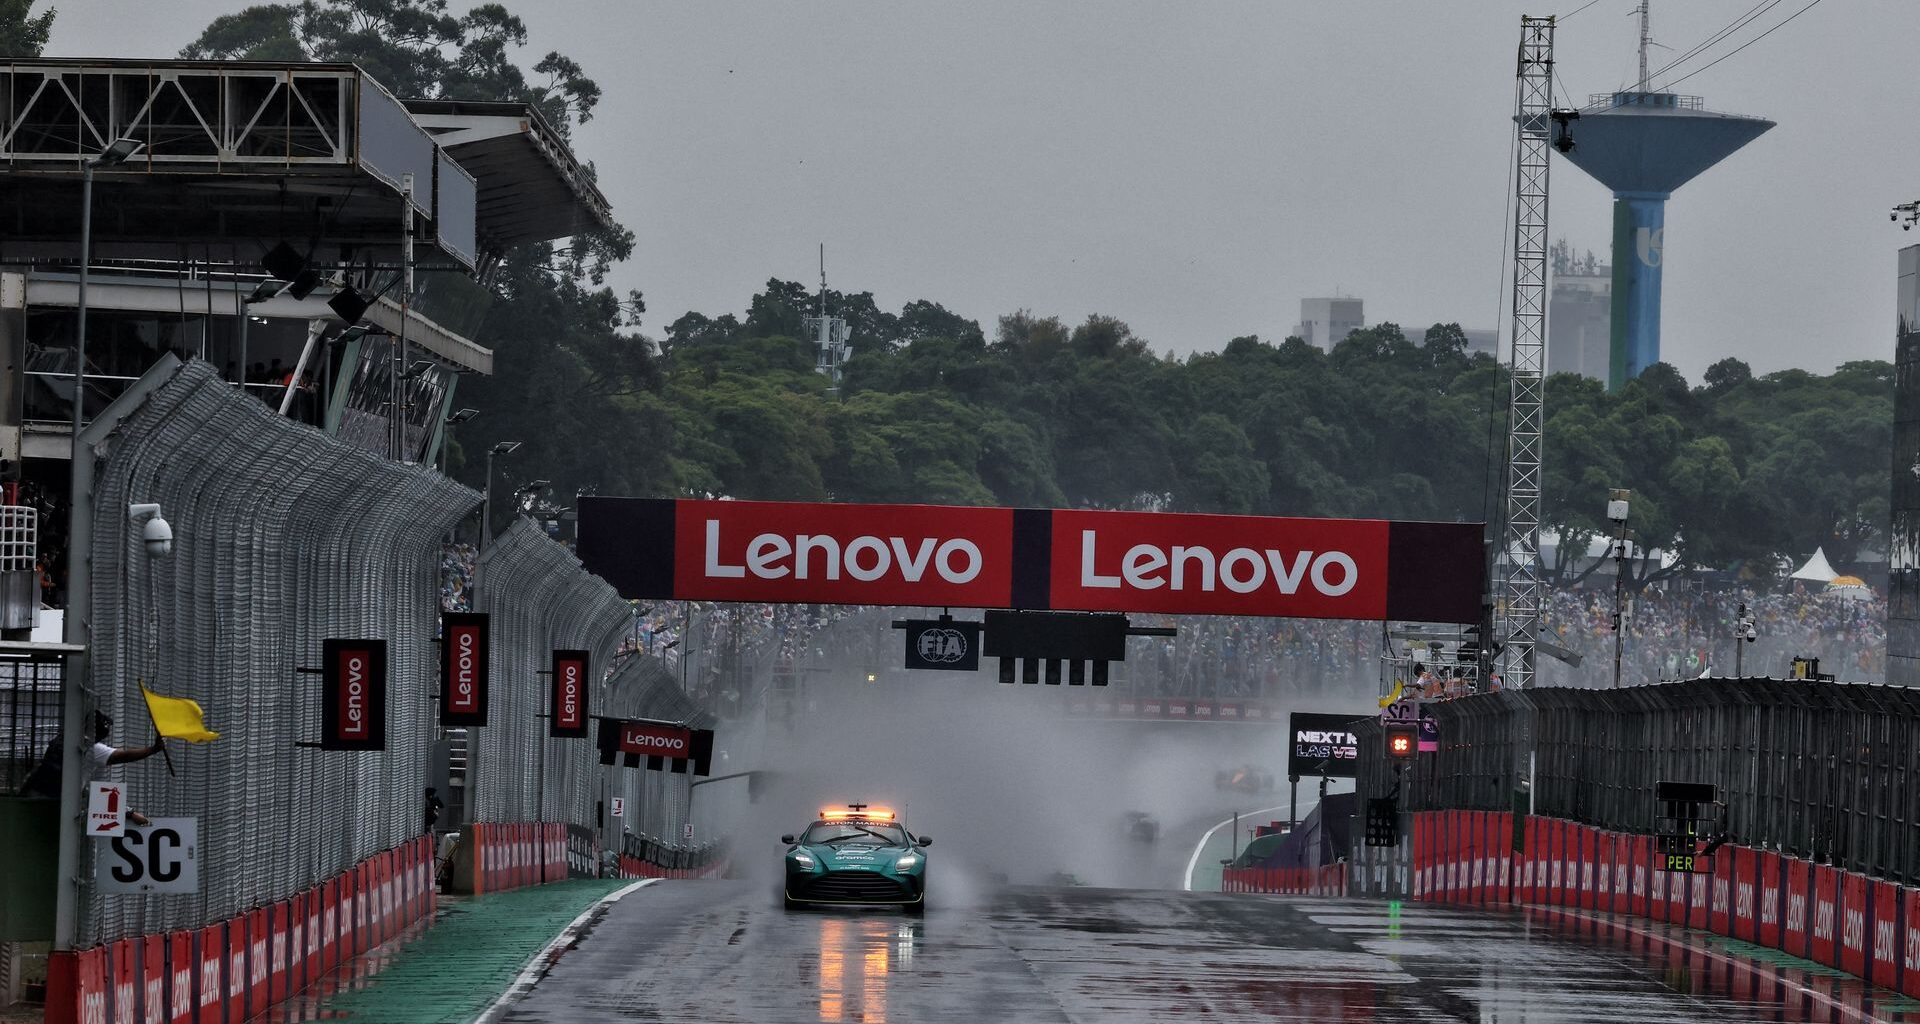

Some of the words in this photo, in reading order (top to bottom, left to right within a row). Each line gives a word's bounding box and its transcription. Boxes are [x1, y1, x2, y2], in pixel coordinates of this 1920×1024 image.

[705, 519, 982, 584] Lenovo
[1081, 530, 1358, 597] Lenovo
[345, 657, 362, 733] Lenovo
[456, 633, 473, 706] Lenovo
[563, 666, 576, 722] Lenovo
[626, 731, 684, 749] Lenovo
[1296, 730, 1345, 744] NEXT
[1296, 744, 1331, 758] LAS
[1394, 738, 1408, 751] SC
[111, 828, 181, 883] SC
[1668, 855, 1693, 871] PER
